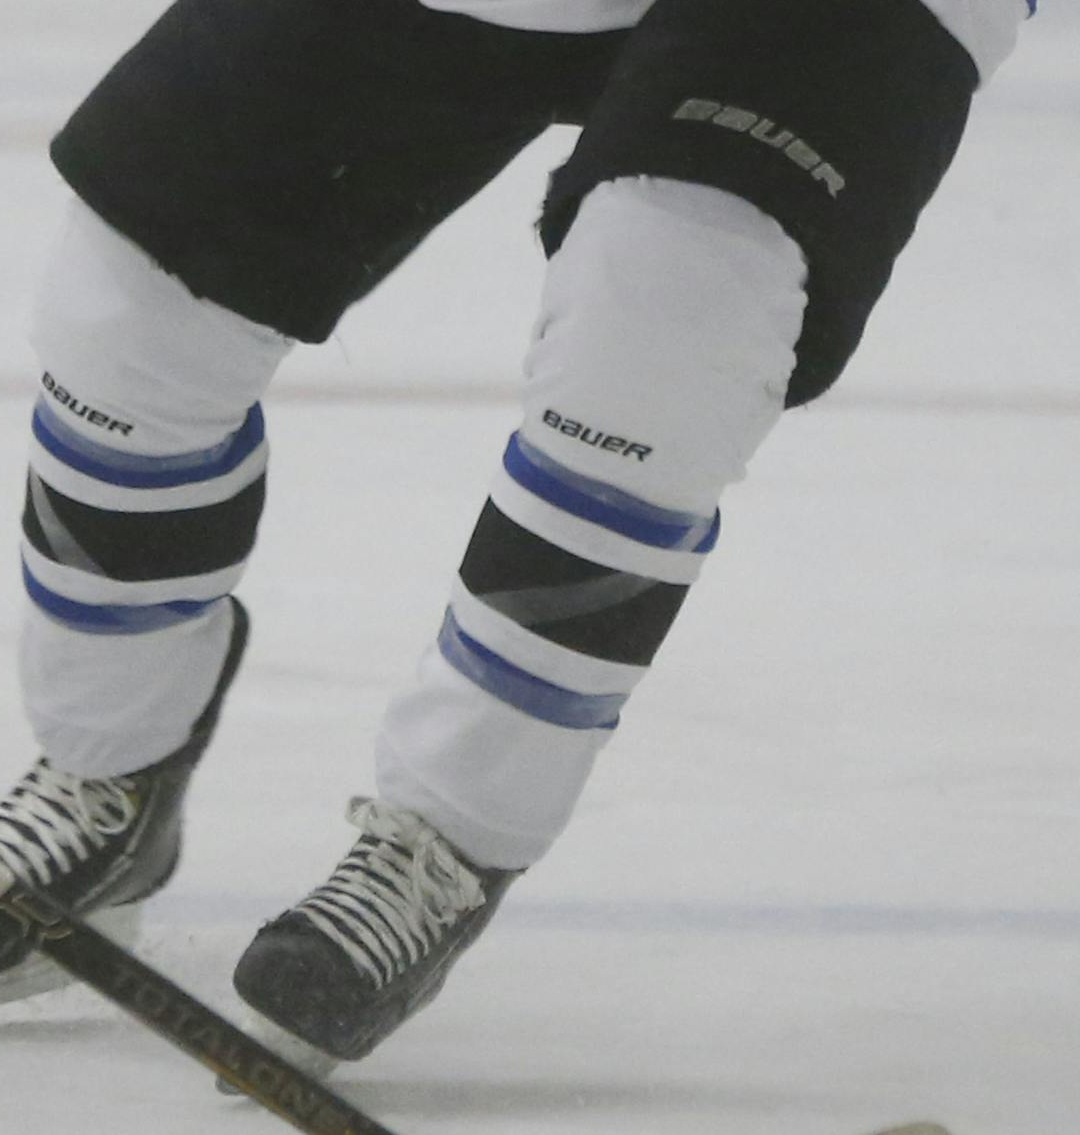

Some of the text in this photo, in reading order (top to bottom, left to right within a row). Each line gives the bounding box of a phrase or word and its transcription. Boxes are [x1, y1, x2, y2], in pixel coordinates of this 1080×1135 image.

[673, 98, 846, 200] BAUER
[42, 371, 134, 437] BAUER
[542, 409, 653, 462] BAUER
